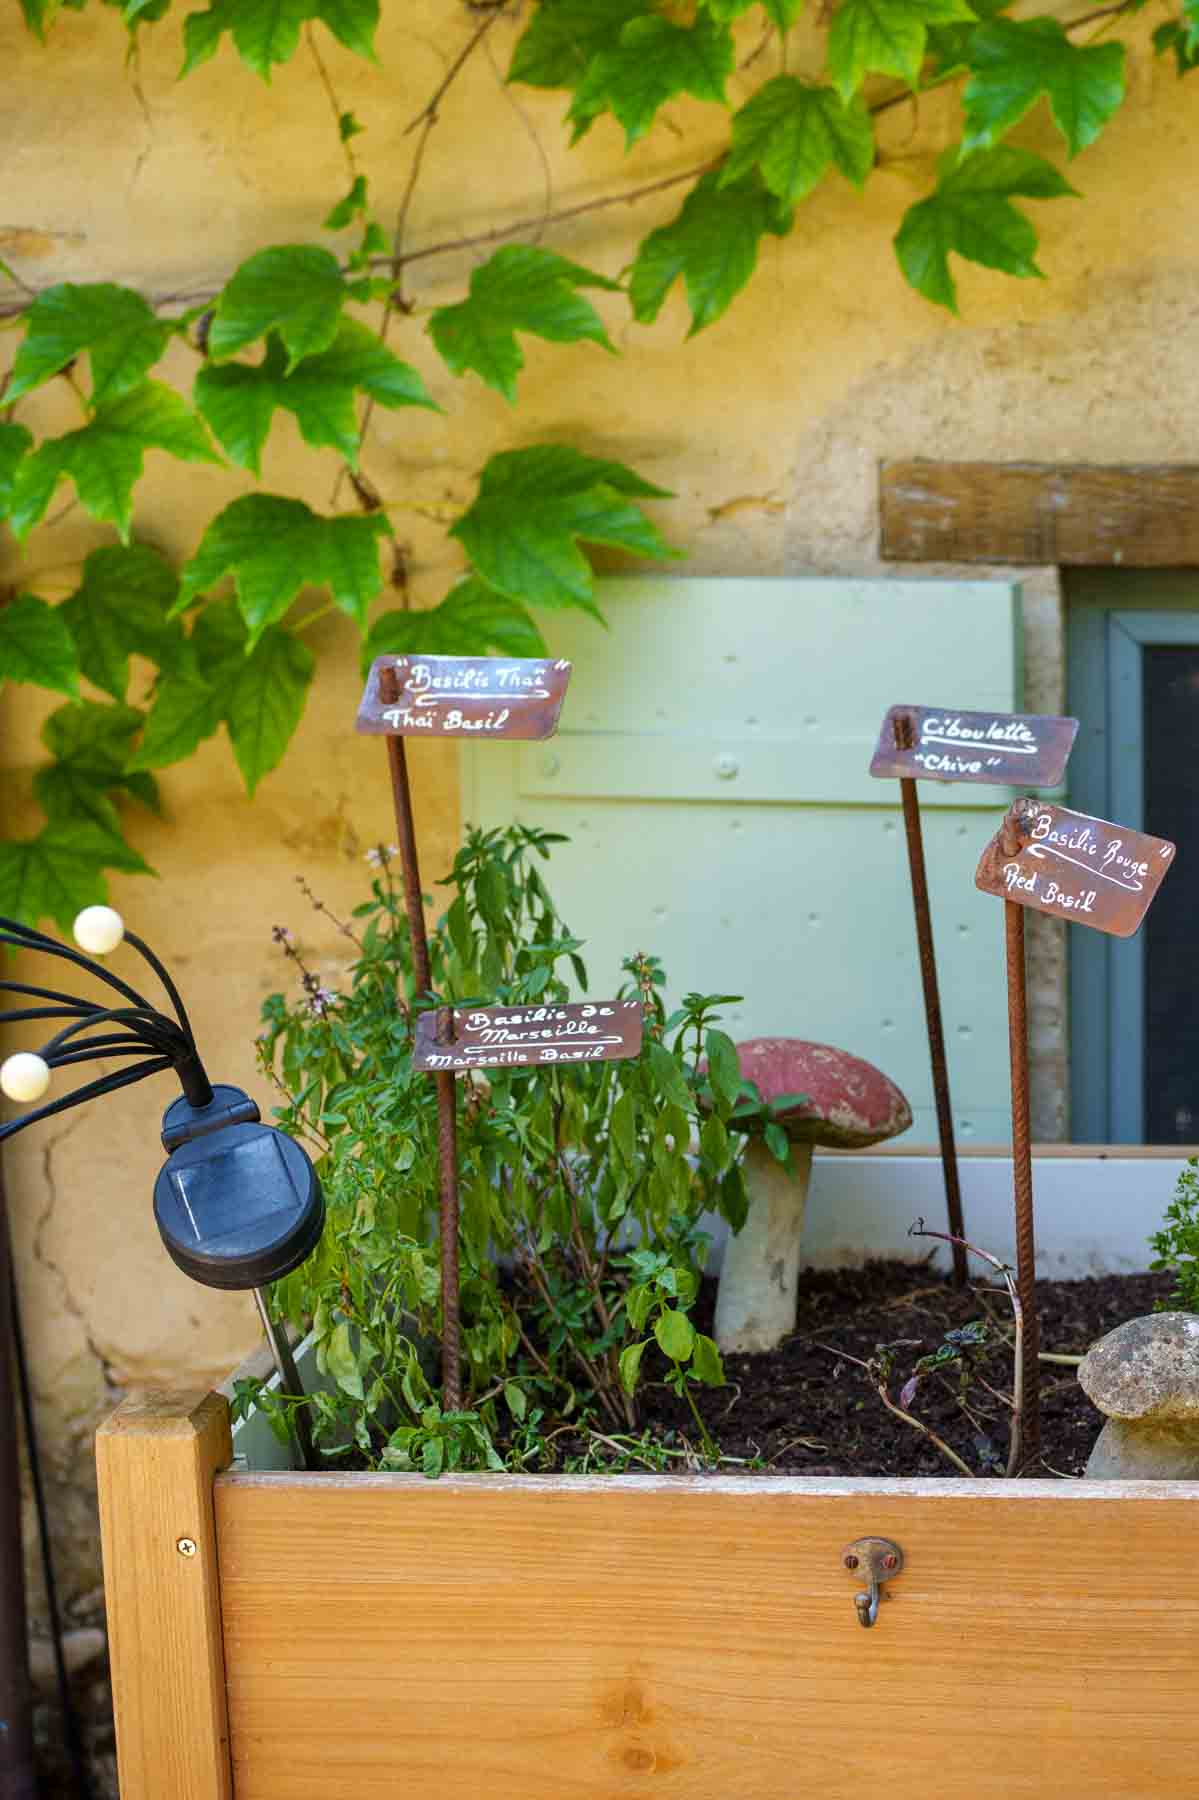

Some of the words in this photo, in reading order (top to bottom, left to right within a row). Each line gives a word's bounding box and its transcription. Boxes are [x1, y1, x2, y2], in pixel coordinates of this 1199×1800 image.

[443, 708, 510, 730] Basil
[922, 718, 1036, 742] Ciboulette
[1003, 863, 1036, 892] Red
[1040, 882, 1097, 912] Basil
[480, 1021, 602, 1043] Marseille
[426, 1052, 529, 1067] Marseille
[539, 1046, 605, 1061] Basil
